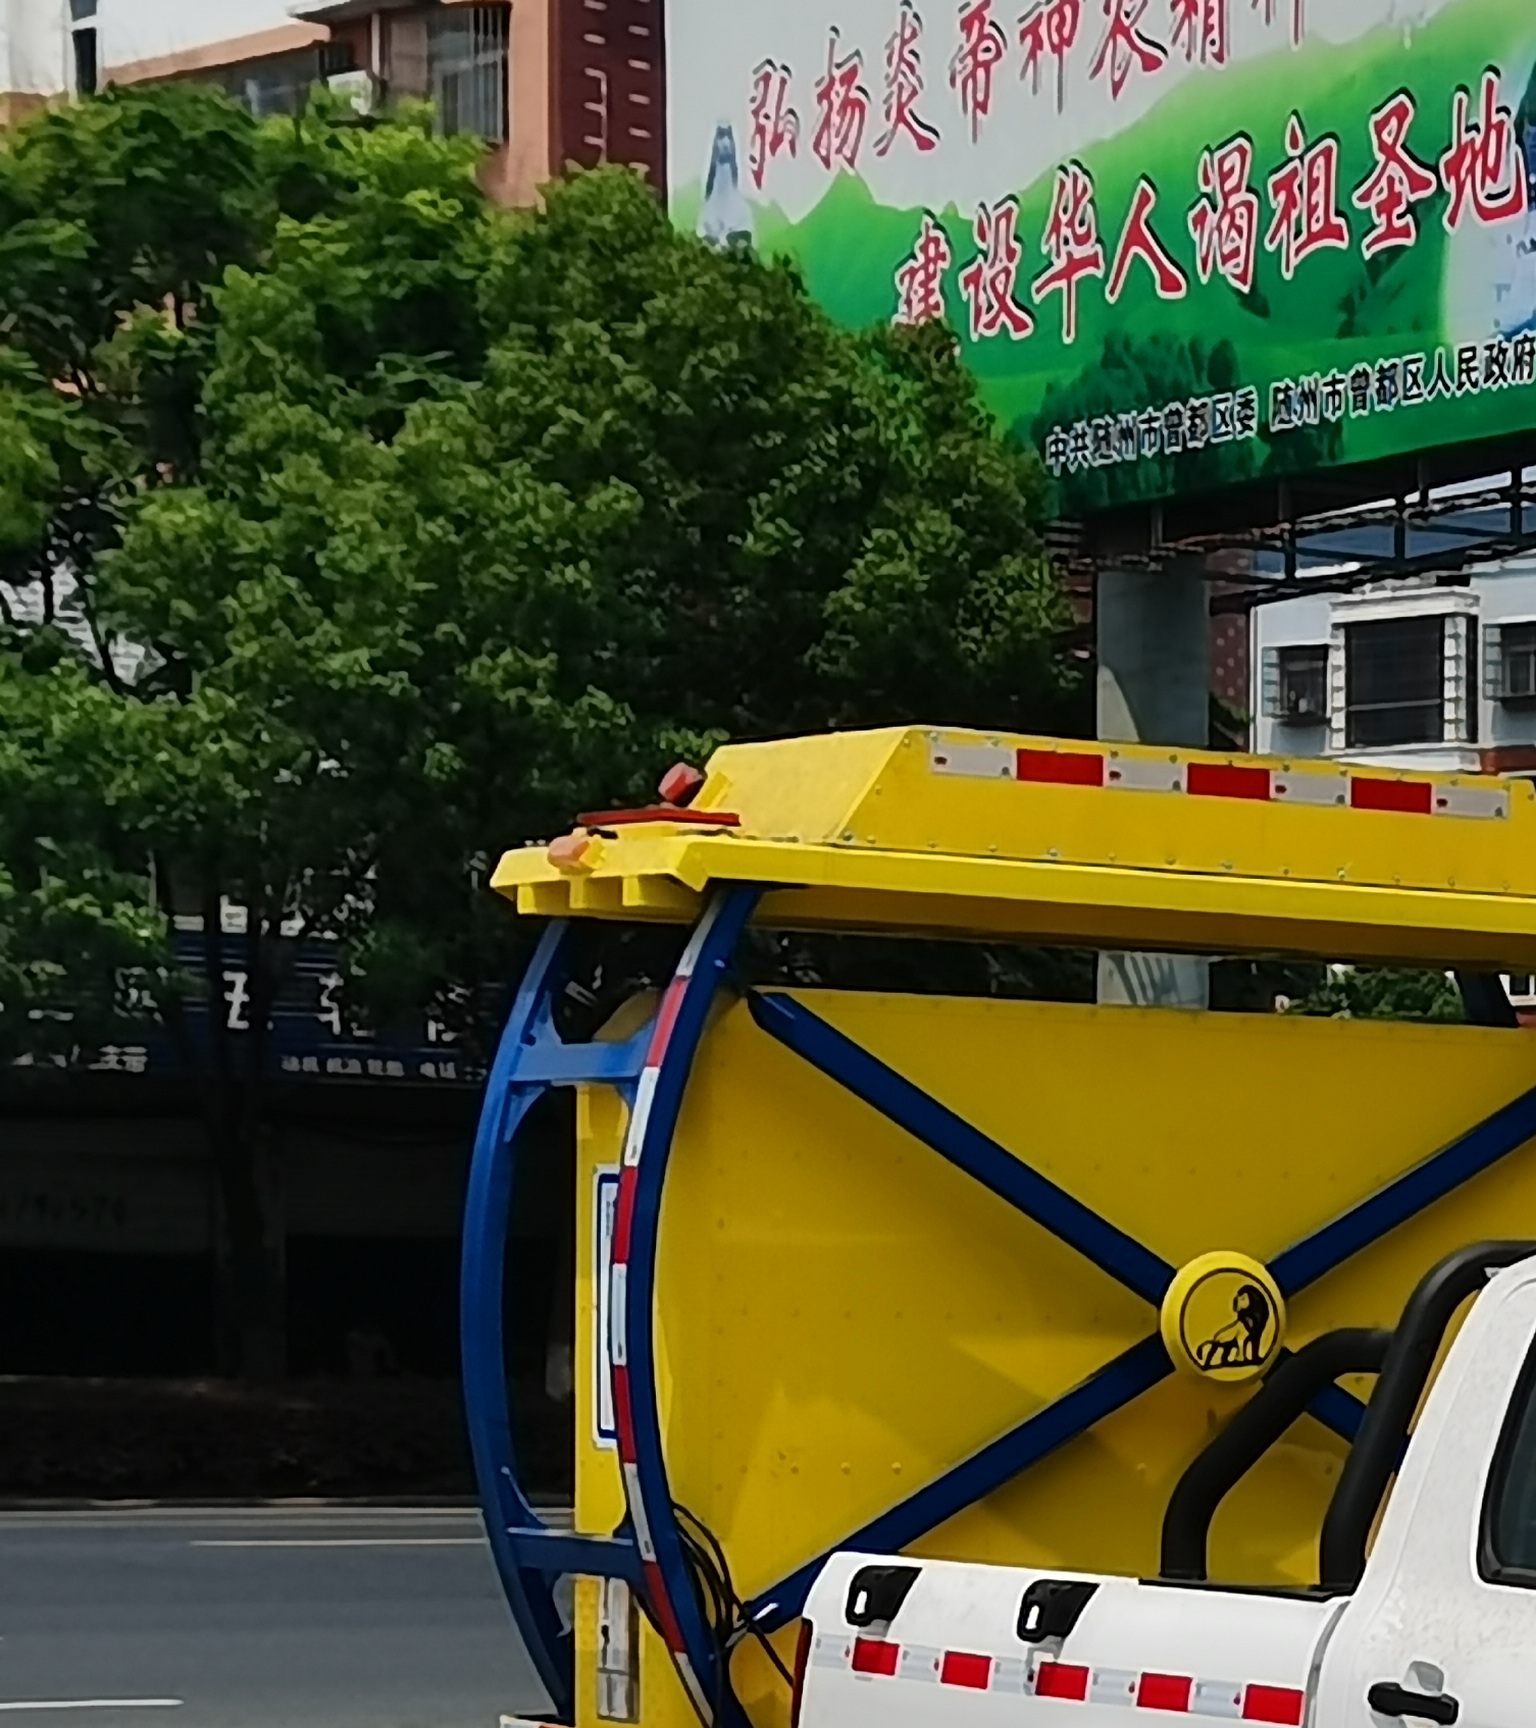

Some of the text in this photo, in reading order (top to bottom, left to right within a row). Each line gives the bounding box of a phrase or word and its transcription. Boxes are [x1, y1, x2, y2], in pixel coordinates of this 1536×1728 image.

[893, 66, 1528, 343] 建设华人谒祖圣地
